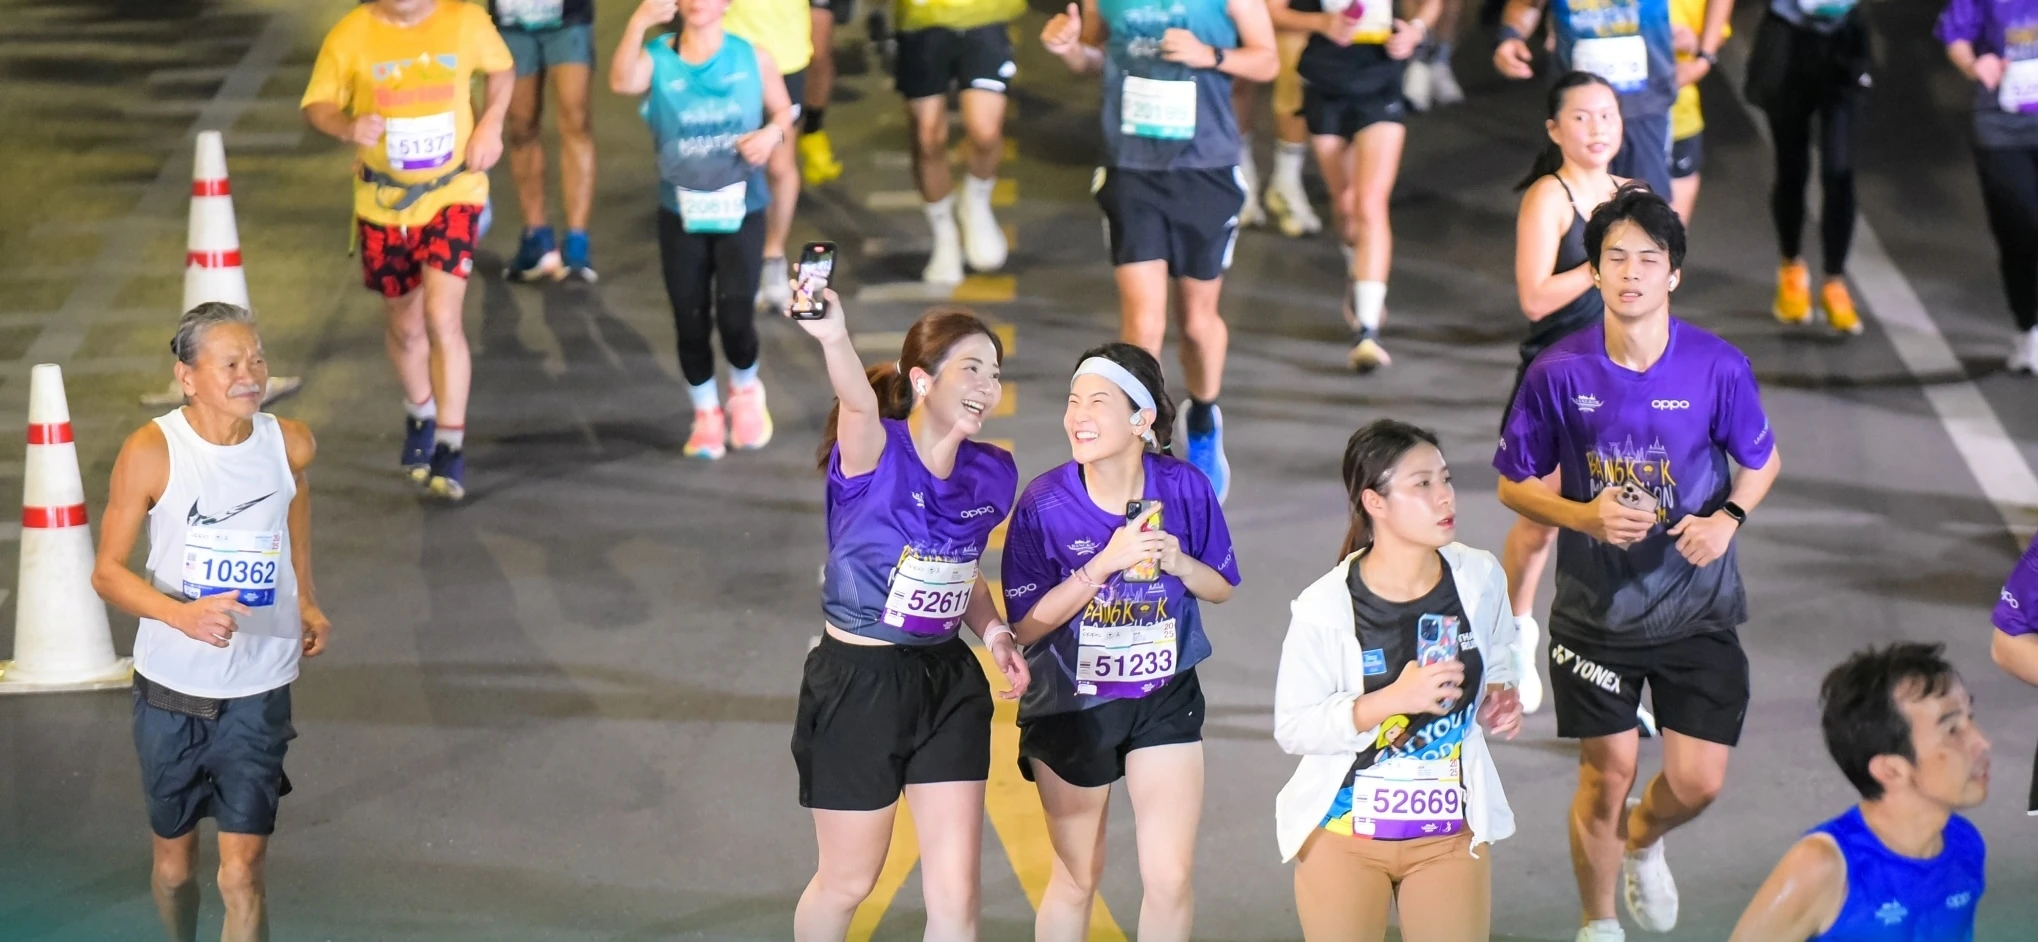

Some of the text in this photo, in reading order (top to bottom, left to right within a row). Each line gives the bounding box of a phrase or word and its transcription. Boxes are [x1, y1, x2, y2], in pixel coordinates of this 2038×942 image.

[1651, 399, 1690, 411] oppo
[960, 505, 995, 519] oppo
[202, 558, 276, 584] 10362
[907, 587, 971, 613] 52611
[1094, 649, 1173, 677] 51233
[1572, 654, 1622, 695] YONEX
[1372, 788, 1459, 815] 52669
